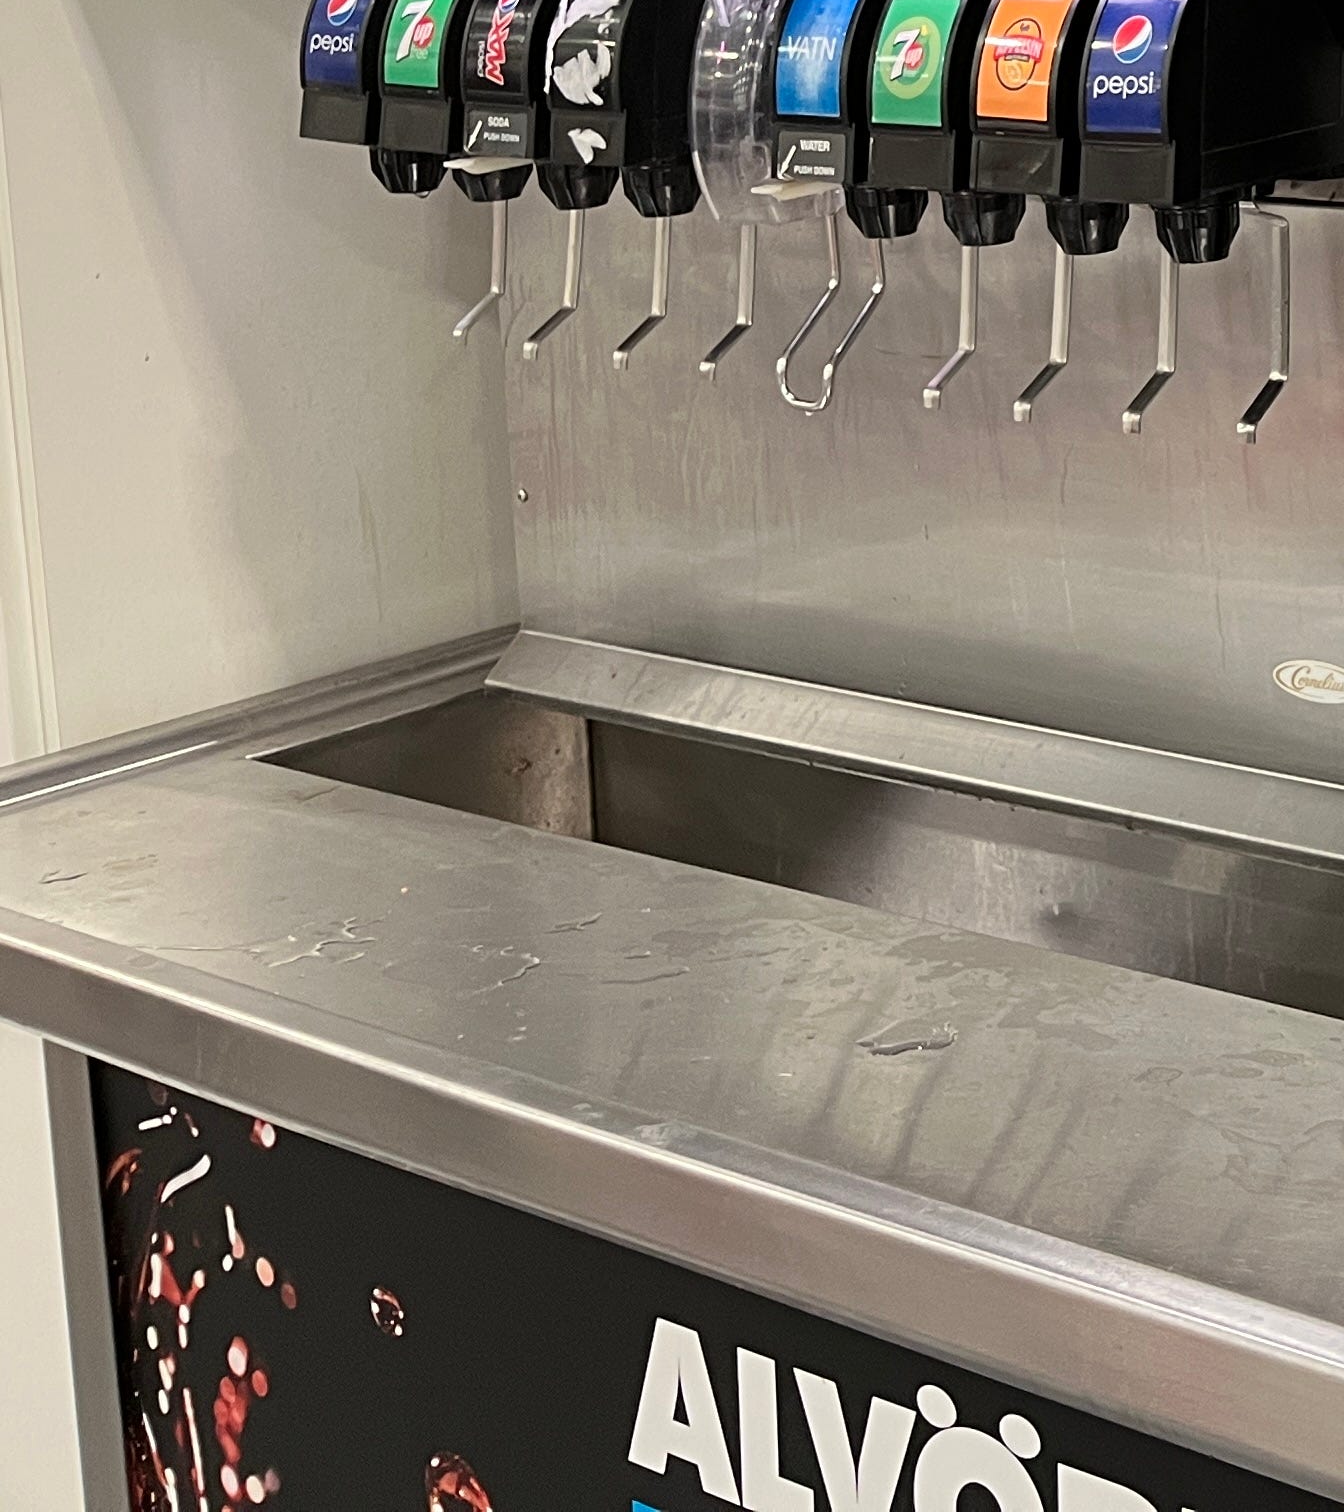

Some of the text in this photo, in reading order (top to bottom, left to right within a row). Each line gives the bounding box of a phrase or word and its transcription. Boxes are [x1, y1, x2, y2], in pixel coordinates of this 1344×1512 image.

[310, 33, 355, 55] pepsi
[485, 6, 515, 85] MAX
[788, 36, 837, 61] VATN
[1093, 71, 1155, 99] pepsi
[800, 139, 831, 153] WATER
